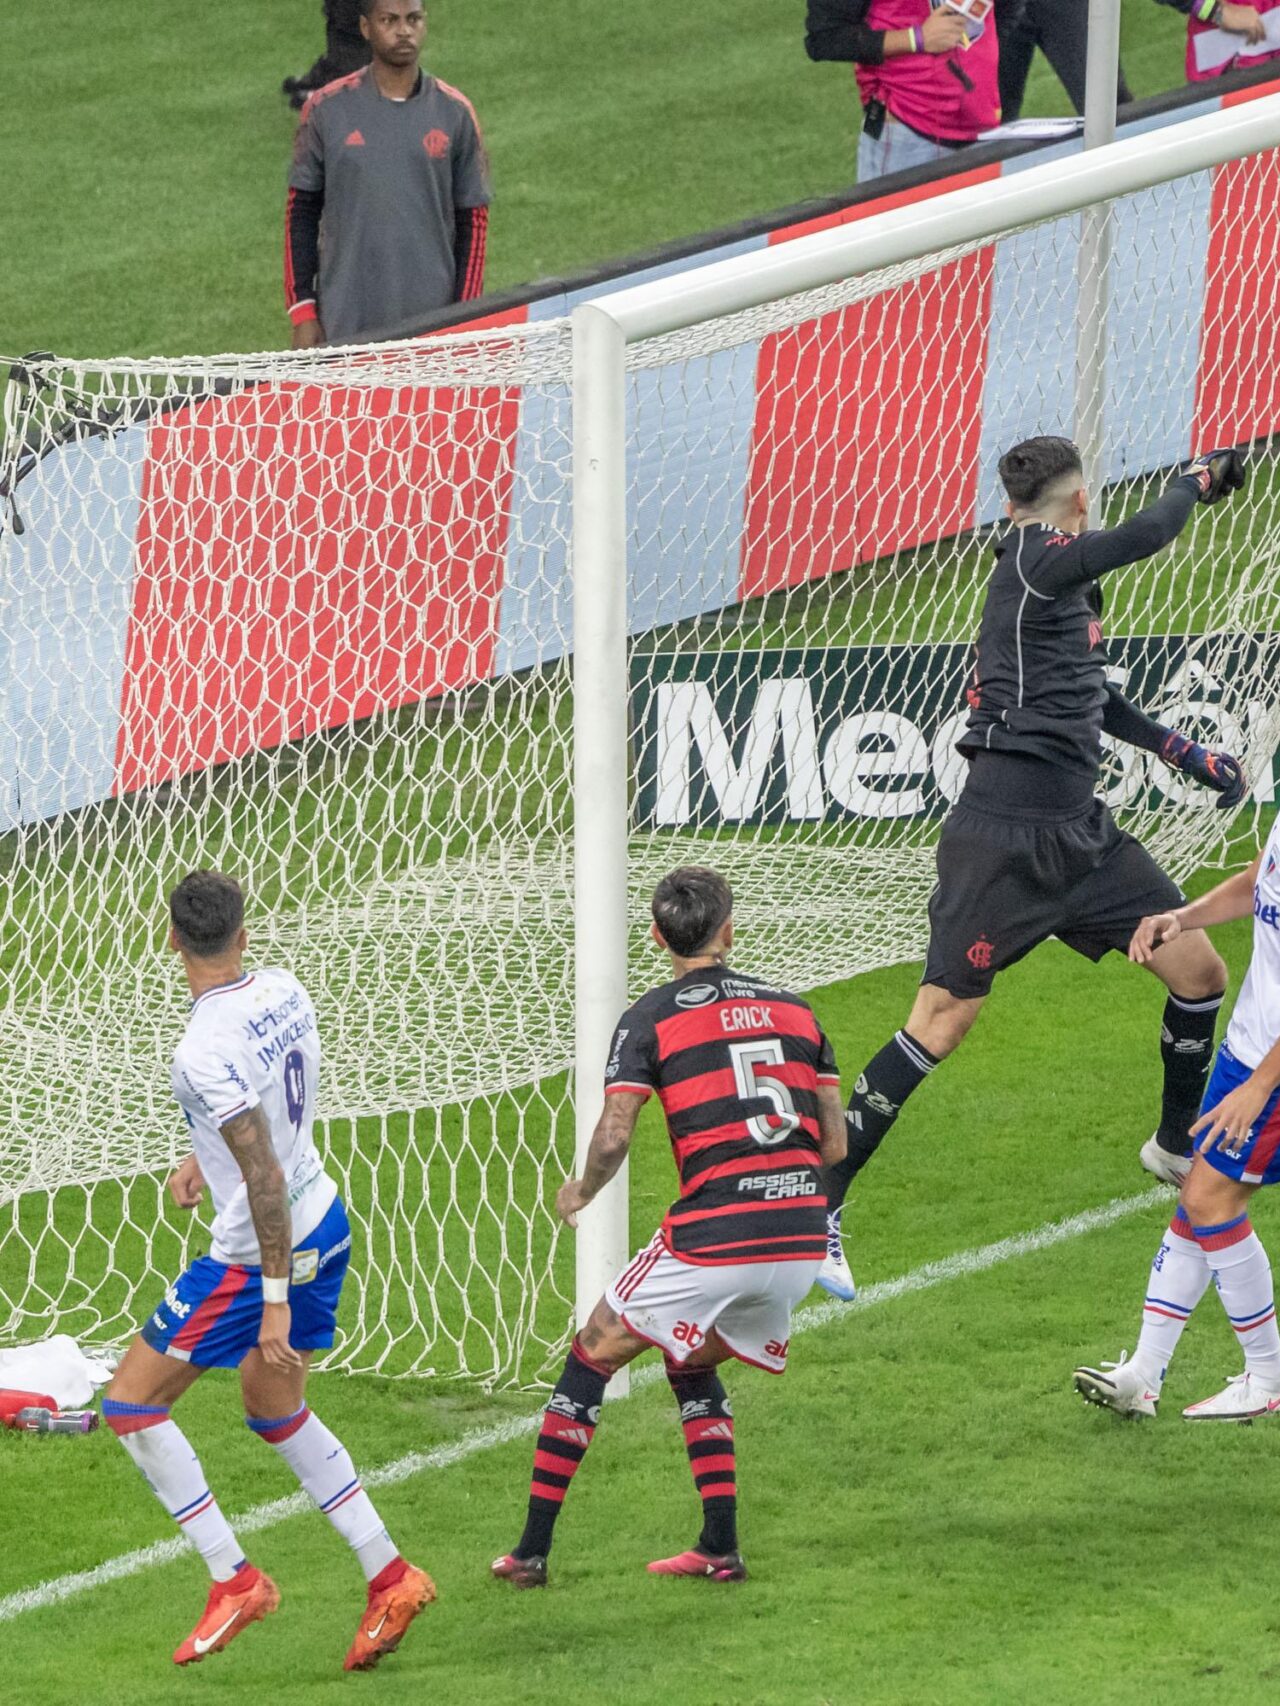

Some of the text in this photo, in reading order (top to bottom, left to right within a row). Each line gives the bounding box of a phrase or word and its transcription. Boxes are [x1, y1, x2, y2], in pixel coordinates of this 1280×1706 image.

[724, 987, 756, 998] livre
[720, 1006, 775, 1031] ERICK
[728, 1038, 800, 1145] 5
[1225, 1148, 1241, 1160] OLT
[738, 1171, 811, 1191] ASSIST
[764, 1182, 817, 1200] CARD
